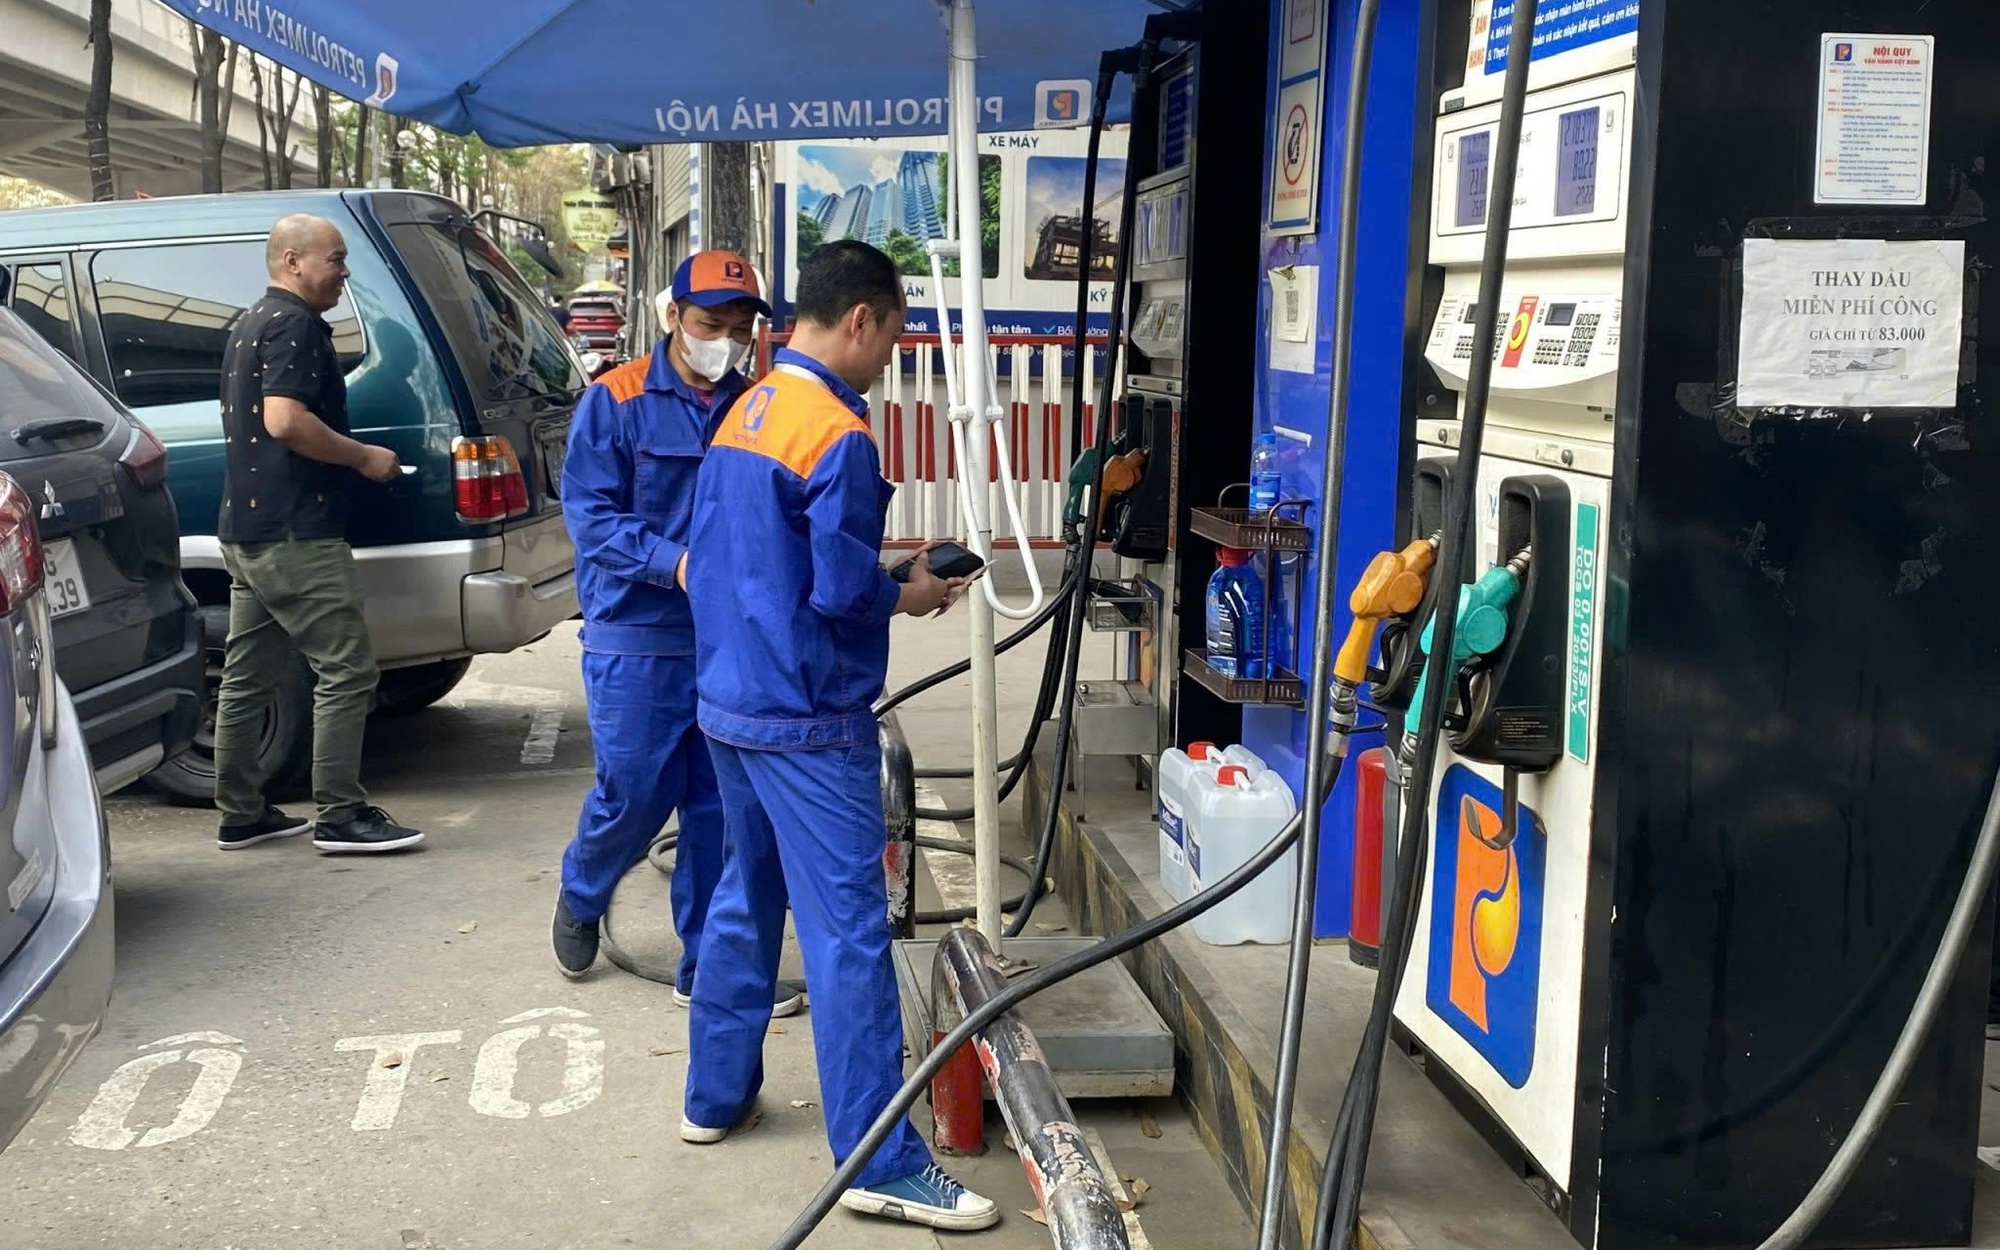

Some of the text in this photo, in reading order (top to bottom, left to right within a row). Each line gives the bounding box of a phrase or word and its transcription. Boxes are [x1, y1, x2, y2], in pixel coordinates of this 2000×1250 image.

[1873, 45, 1912, 57] NỘI QUY
[989, 132, 1039, 149] XE MÁY
[1812, 266, 1911, 288] THAY DẦU
[1782, 294, 1938, 316] MIỄN PHÍ CÔNG
[992, 324, 1009, 334] tận
[1011, 324, 1032, 334] tâm
[1809, 326, 1830, 341] GIÁ
[1834, 326, 1856, 341] CHỈ
[1878, 326, 1925, 341] 83.000
[1576, 544, 1584, 593] TCCS
[1582, 548, 1594, 591] DO
[68, 1005, 606, 1151] Ô TÔ
